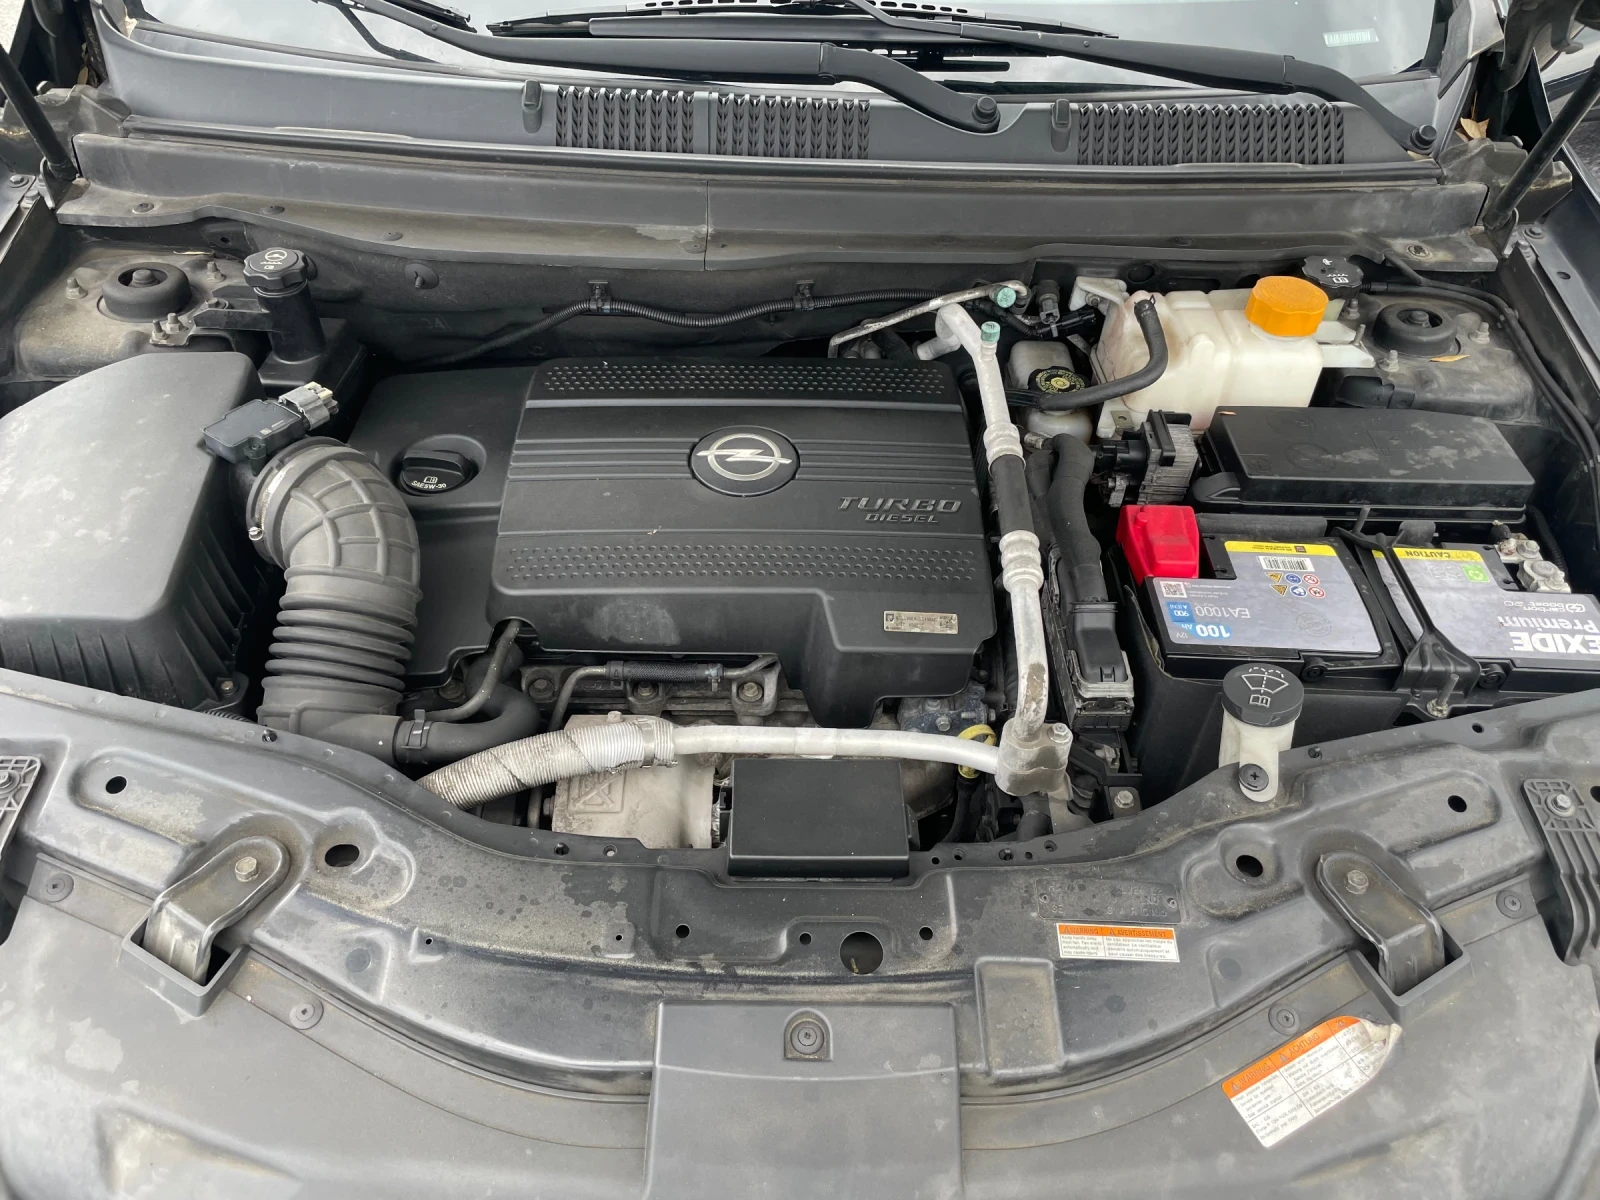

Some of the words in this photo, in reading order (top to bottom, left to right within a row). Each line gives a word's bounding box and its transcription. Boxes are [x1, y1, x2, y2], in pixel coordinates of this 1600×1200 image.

[837, 497, 962, 513] TURBO
[864, 513, 939, 523] DIESEL
[1405, 550, 1451, 558] CAUTION
[1195, 606, 1251, 618] EA1000
[1195, 624, 1231, 638] 100
[1497, 616, 1600, 633] Premium
[1176, 631, 1189, 639] 12V
[1509, 632, 1600, 654] EXIDE
[1070, 927, 1099, 935] WARNING
[1117, 929, 1166, 938] AVERTISSEMENT
[1289, 1032, 1320, 1055] ACHTUNG
[1238, 1062, 1271, 1085] WARNING
